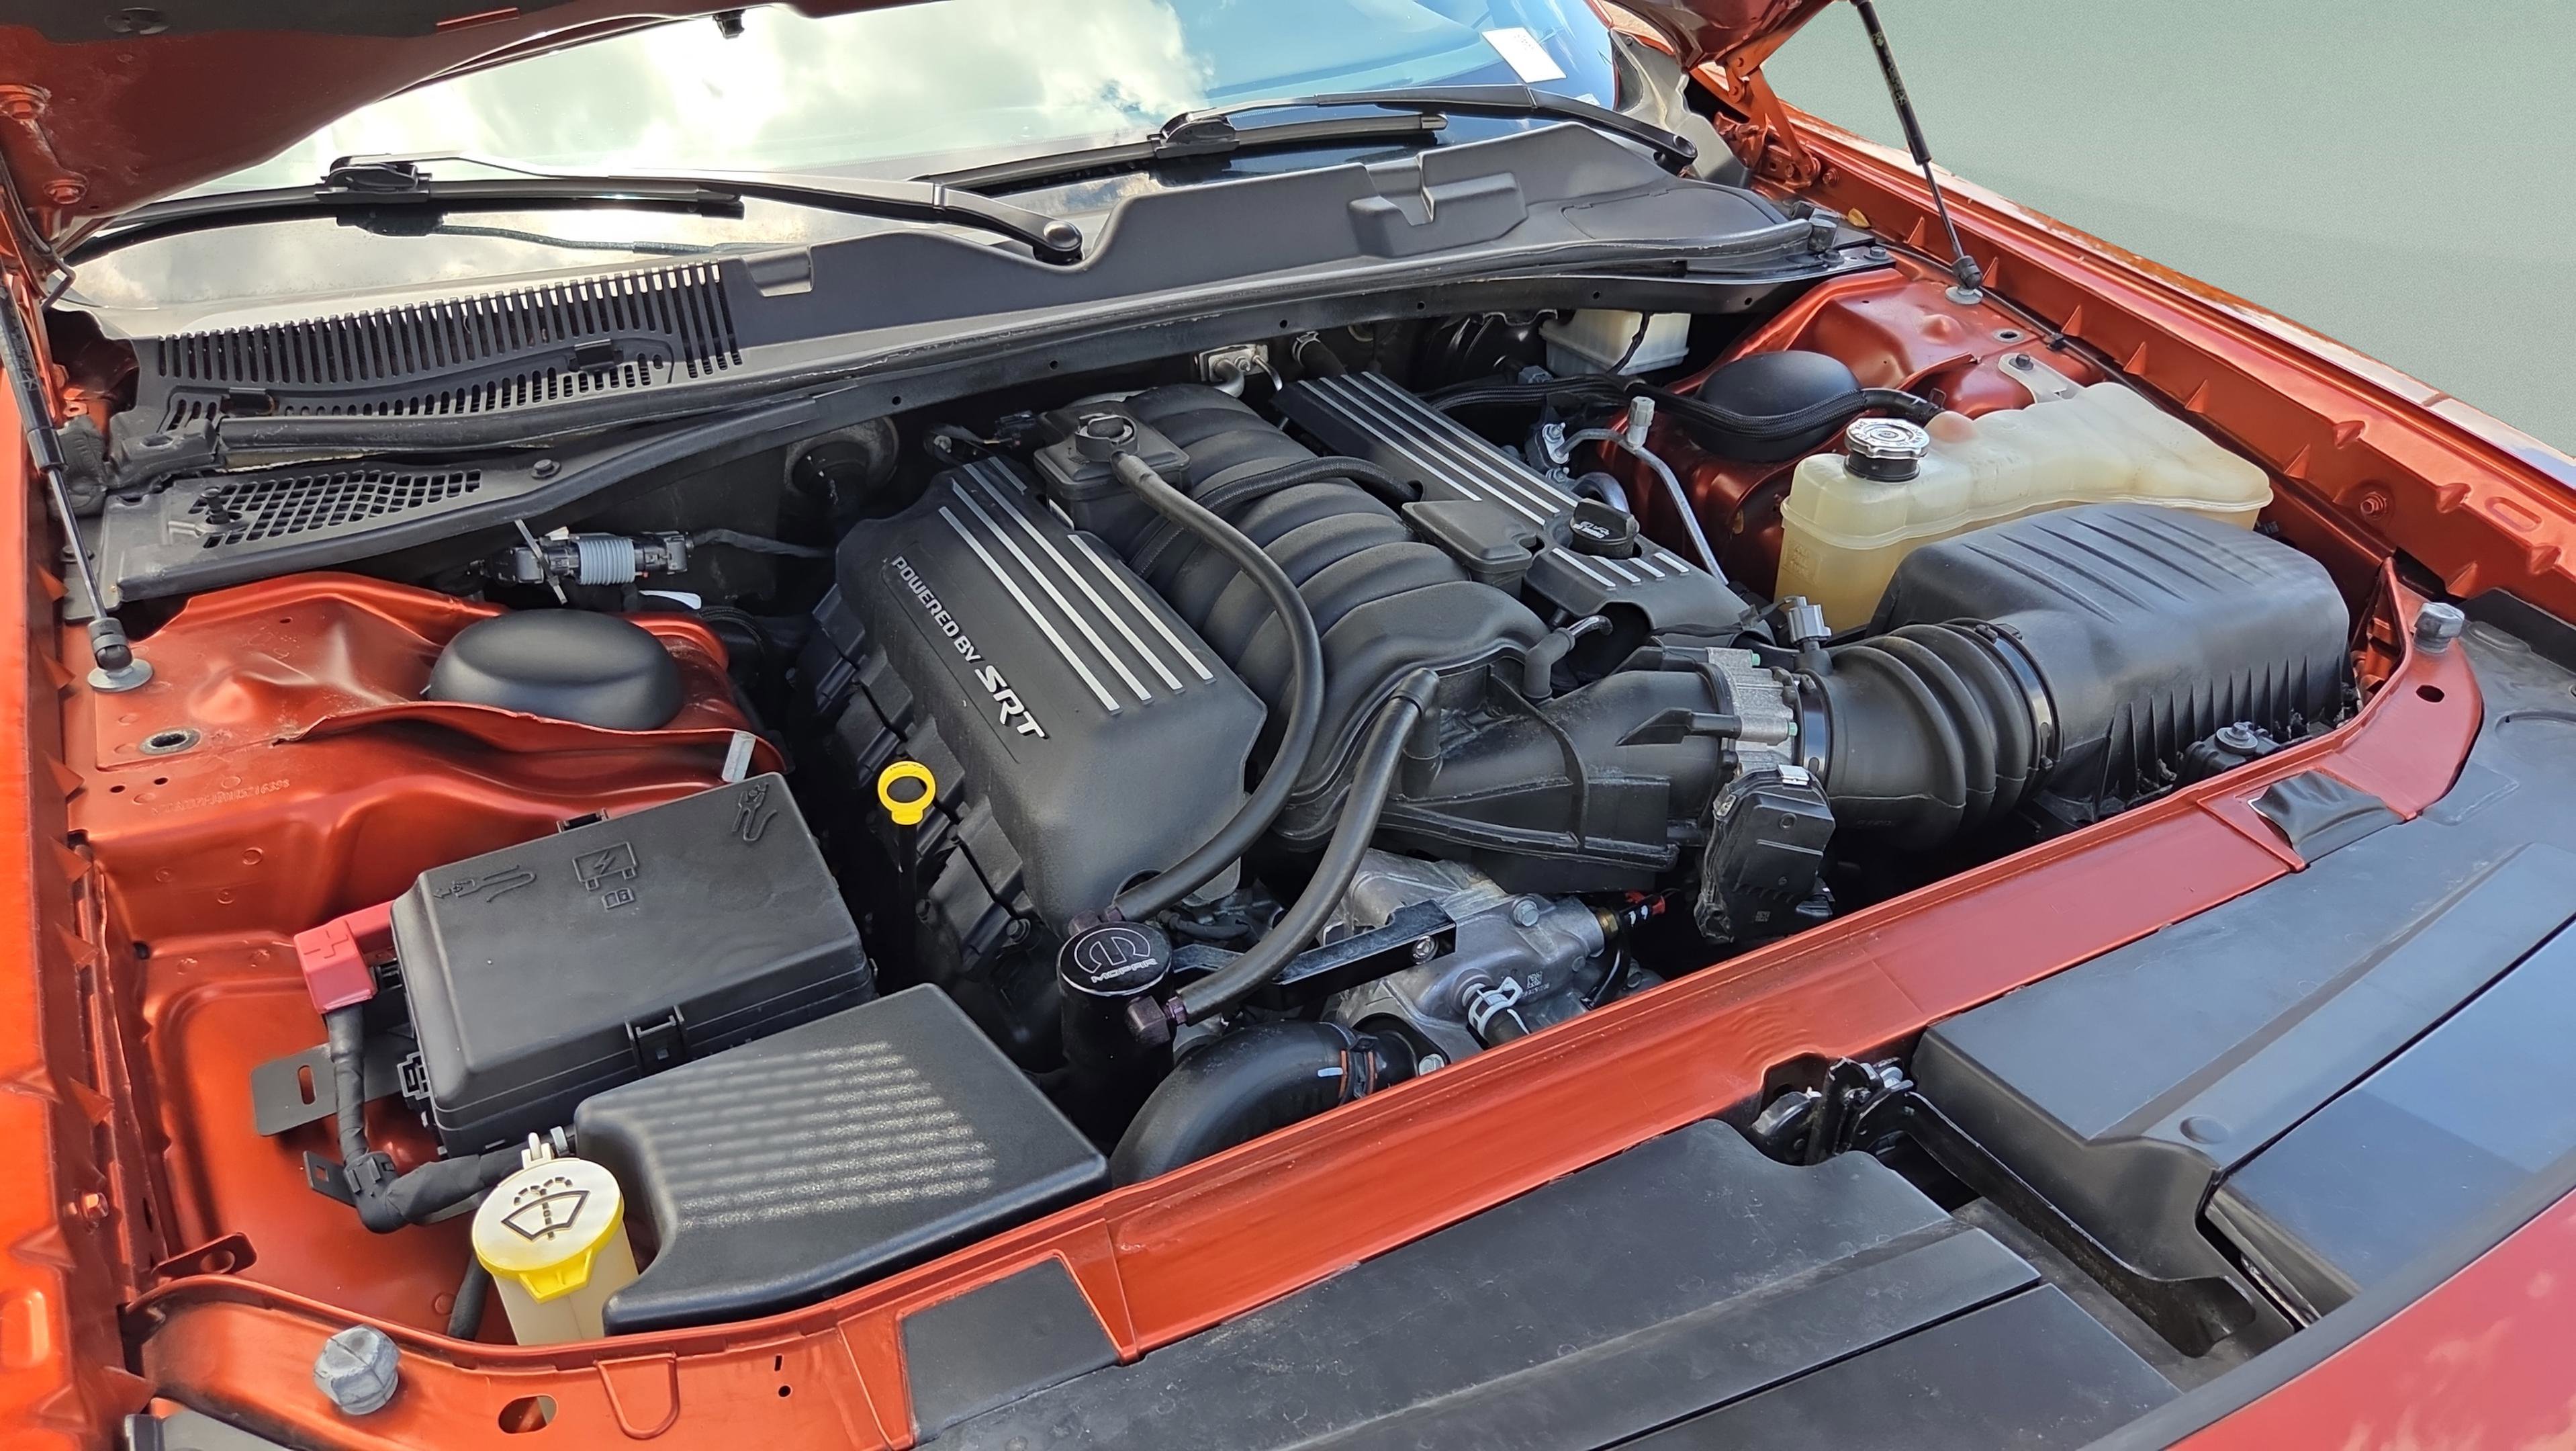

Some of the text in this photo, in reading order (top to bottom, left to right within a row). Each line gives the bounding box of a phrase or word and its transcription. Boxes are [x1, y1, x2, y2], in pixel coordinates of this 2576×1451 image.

[892, 556, 1046, 738] POWERED BY SRT
[1091, 958, 1158, 983] MOPAR
